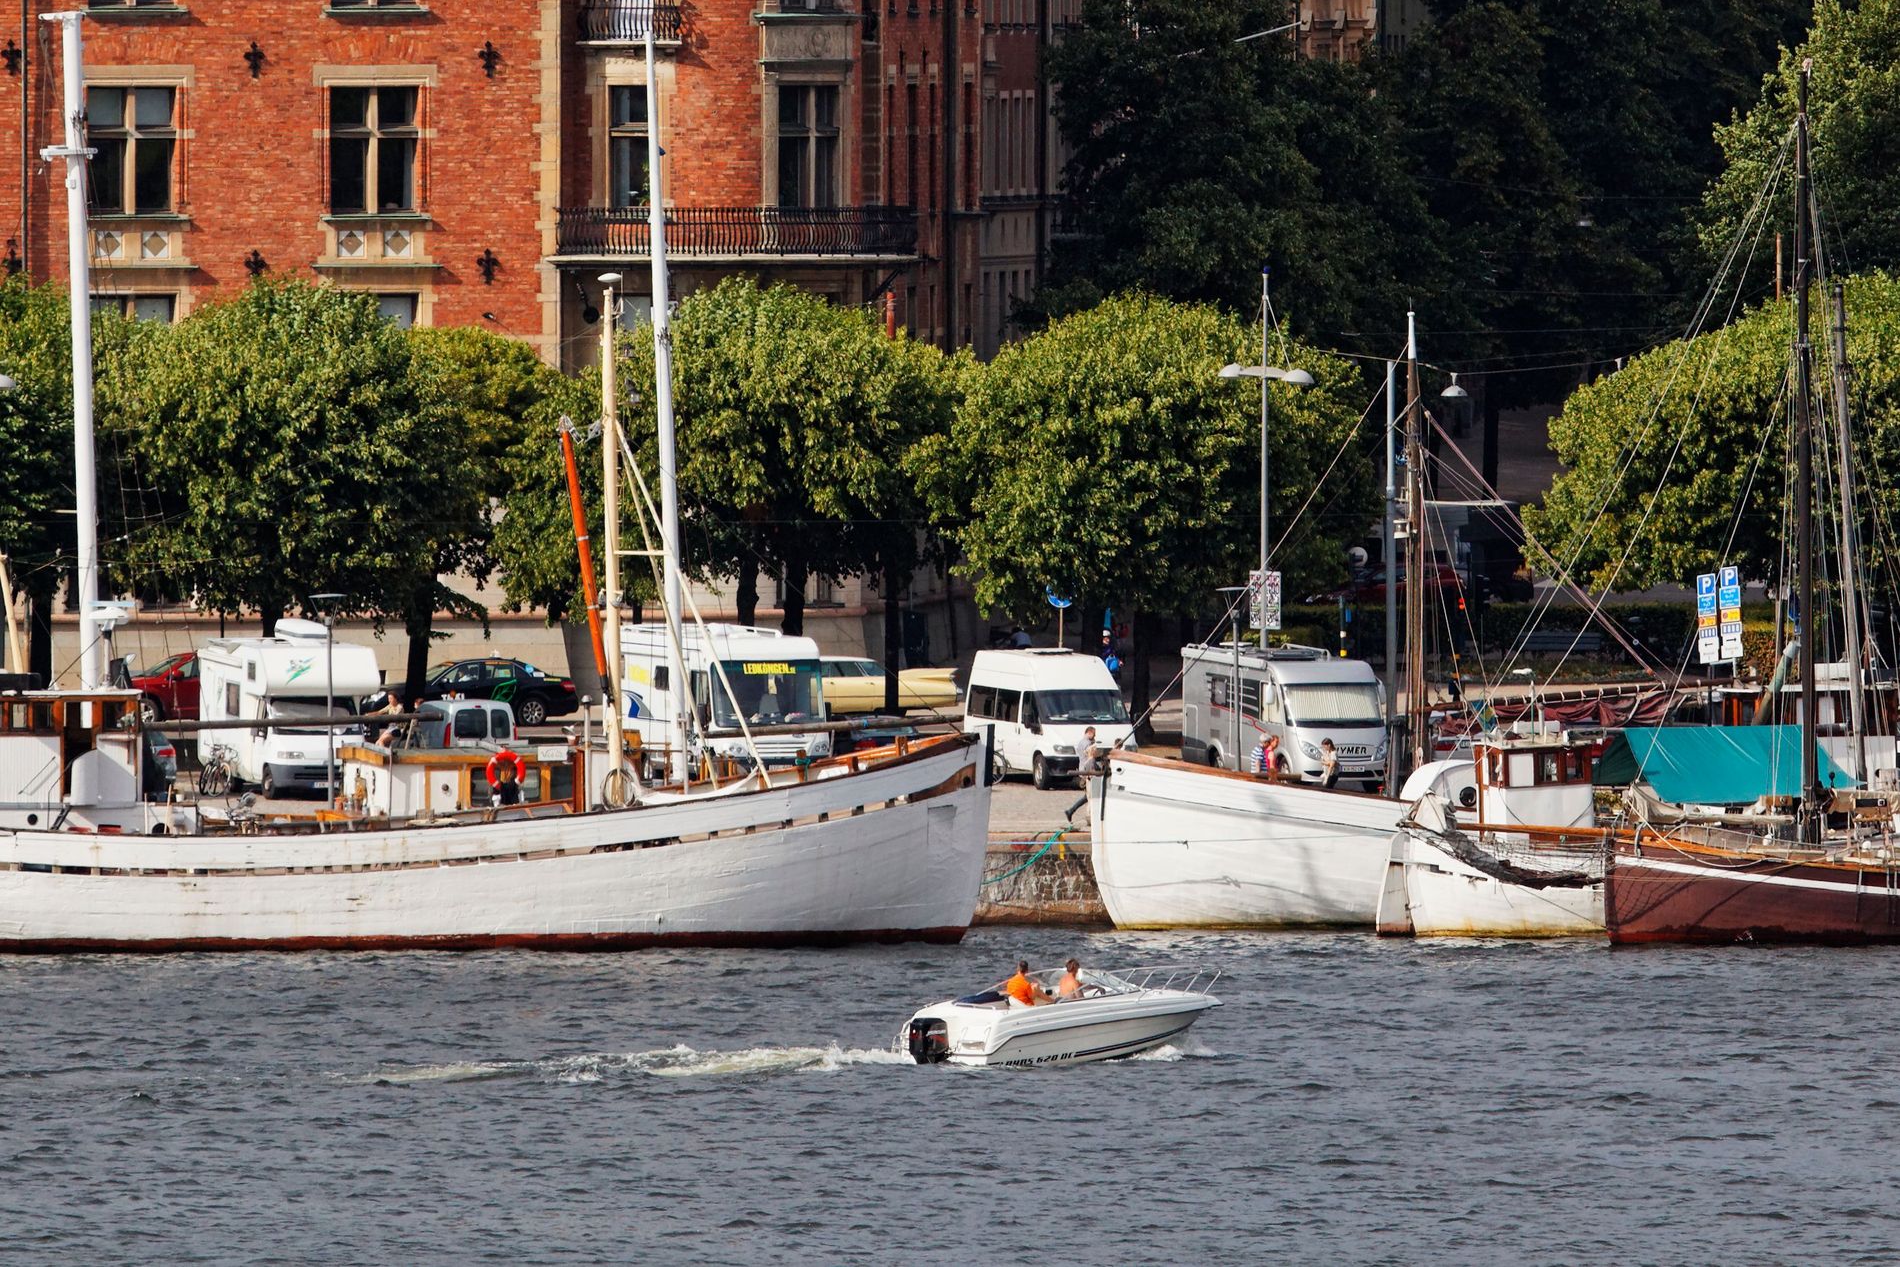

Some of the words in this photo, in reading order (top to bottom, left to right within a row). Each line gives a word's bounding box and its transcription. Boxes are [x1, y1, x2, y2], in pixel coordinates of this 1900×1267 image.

[1702, 577, 1712, 594] P
[1725, 569, 1735, 586] P
[1036, 1054, 1059, 1063] 620
